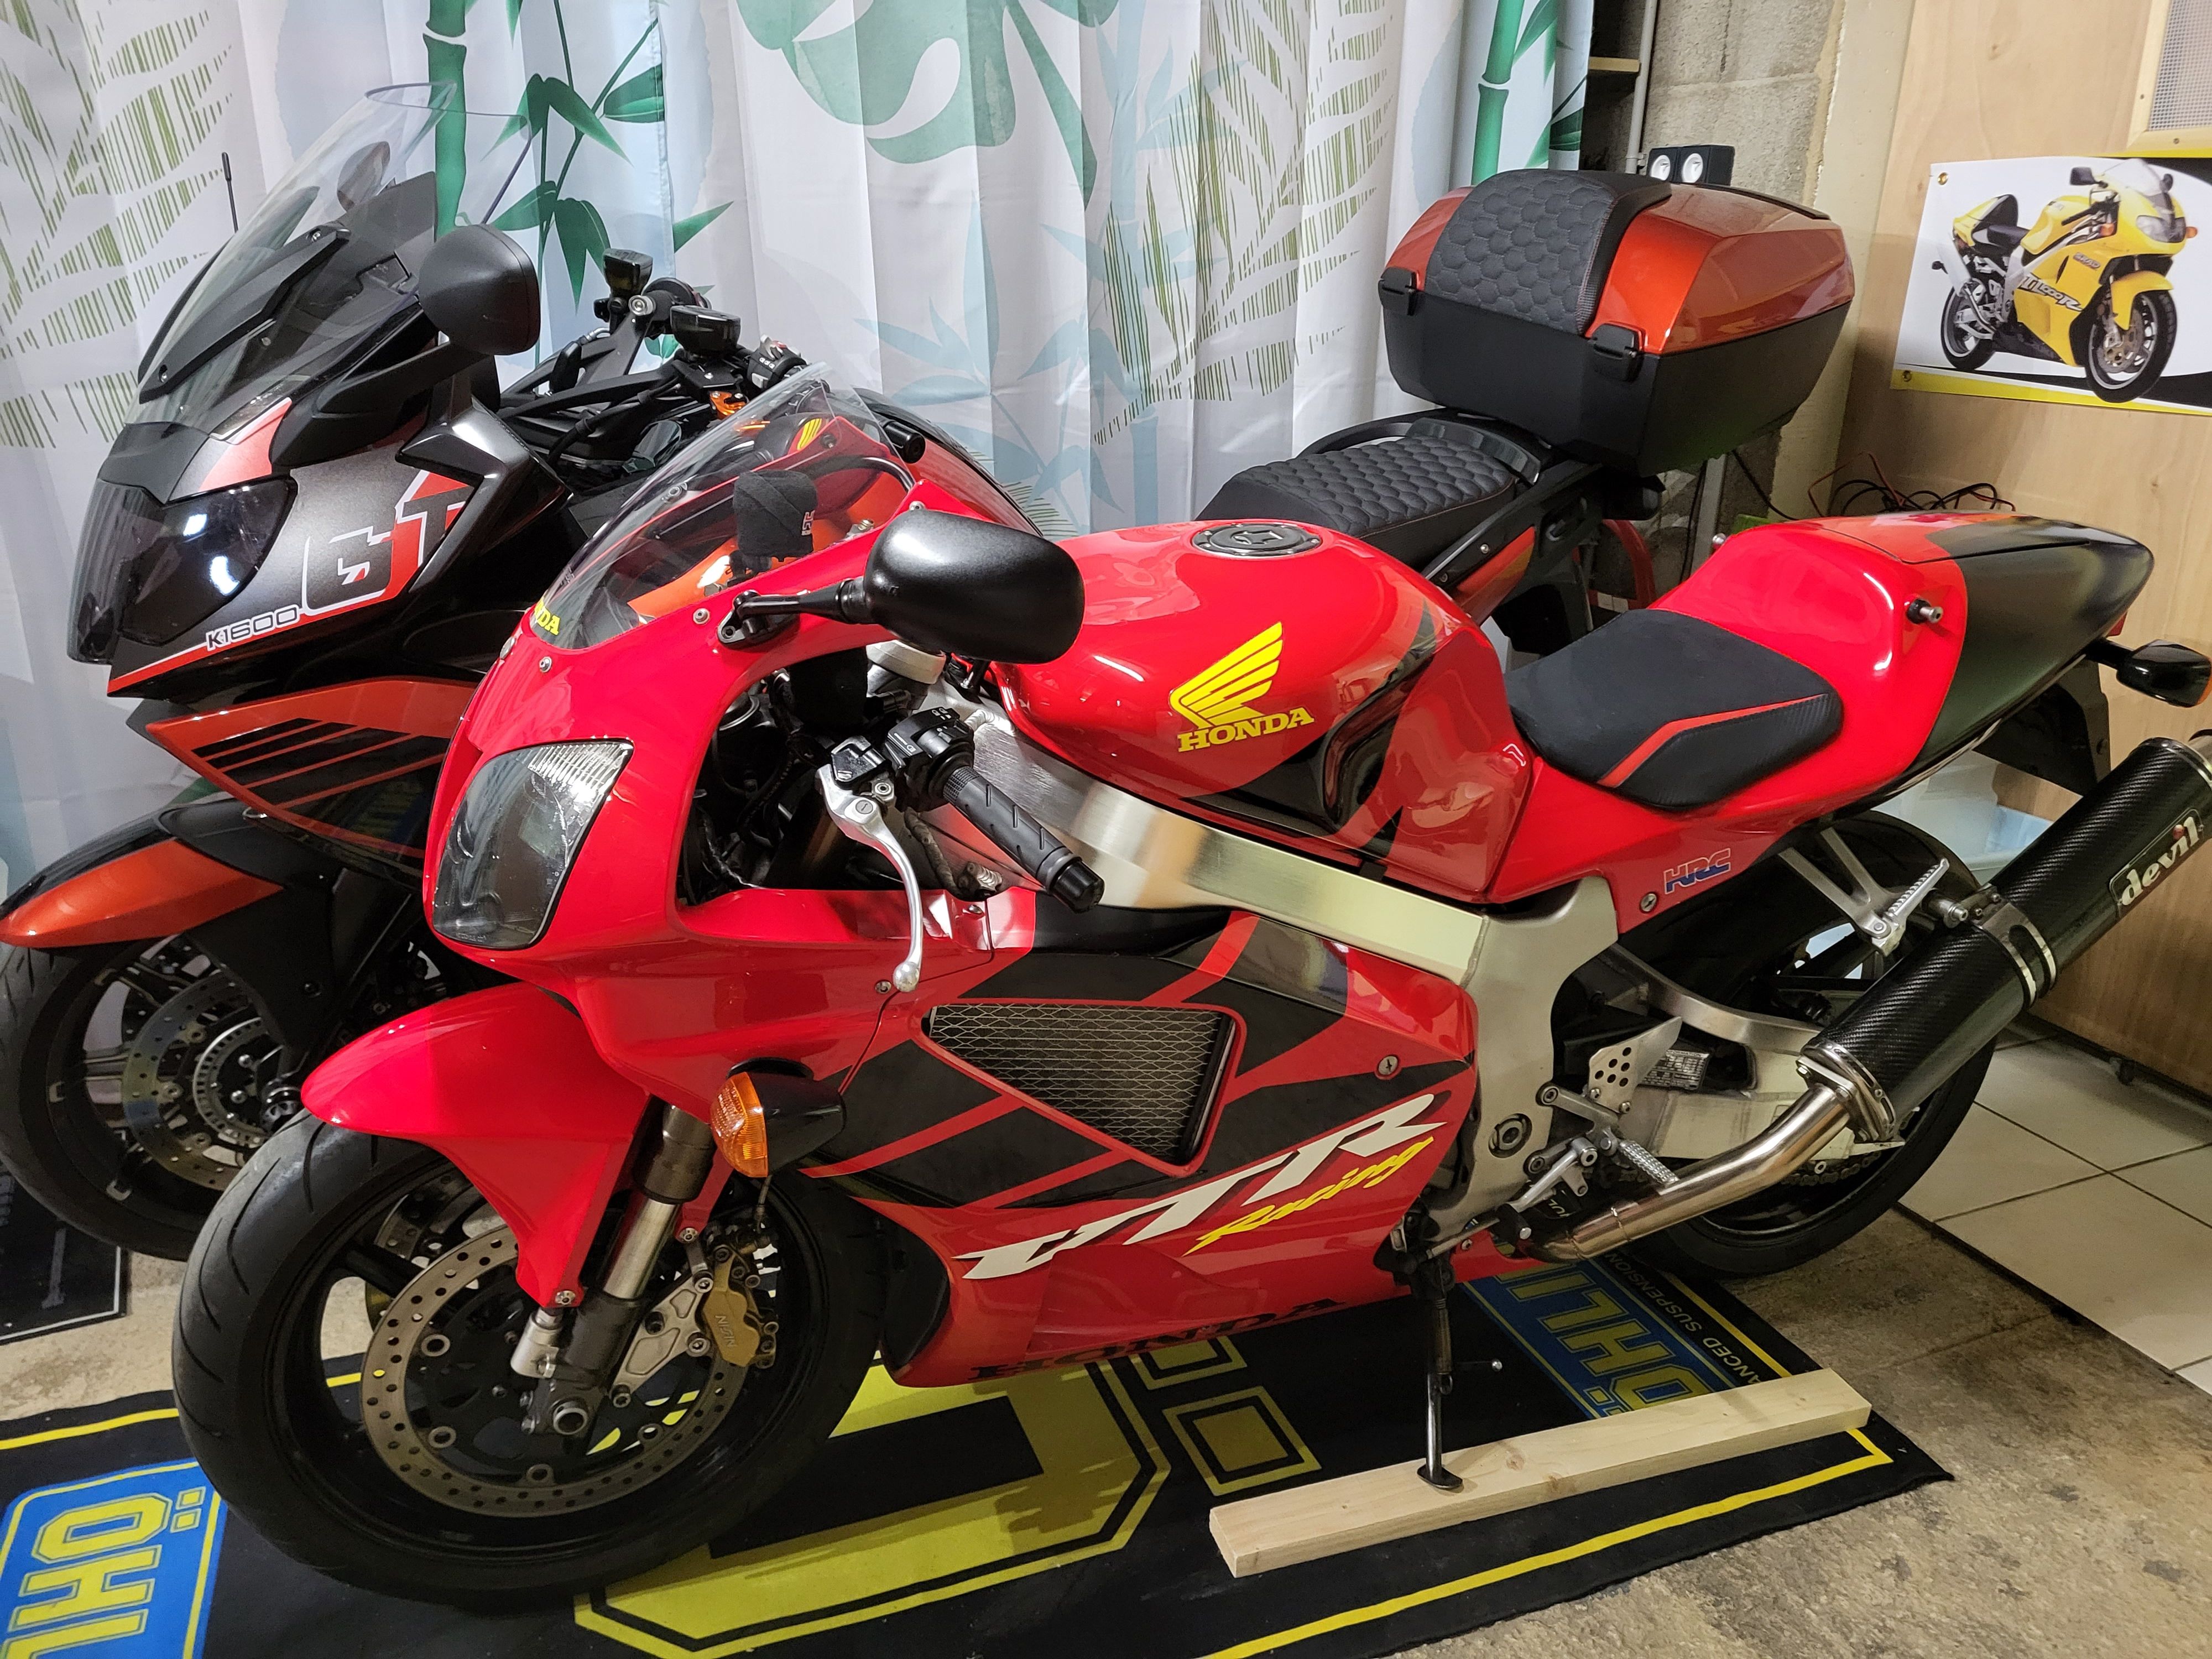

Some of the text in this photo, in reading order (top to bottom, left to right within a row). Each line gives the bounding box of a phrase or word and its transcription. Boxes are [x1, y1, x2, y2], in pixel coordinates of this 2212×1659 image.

[206, 604, 300, 650] K1600
[1177, 707, 1315, 753] HONDA
[1663, 848, 1731, 894] HRC
[2121, 816, 2200, 906] devil
[951, 1093, 1447, 1279] VTR
[1181, 1136, 1434, 1256] Racing
[1605, 1253, 1702, 1332] SUSPENSION
